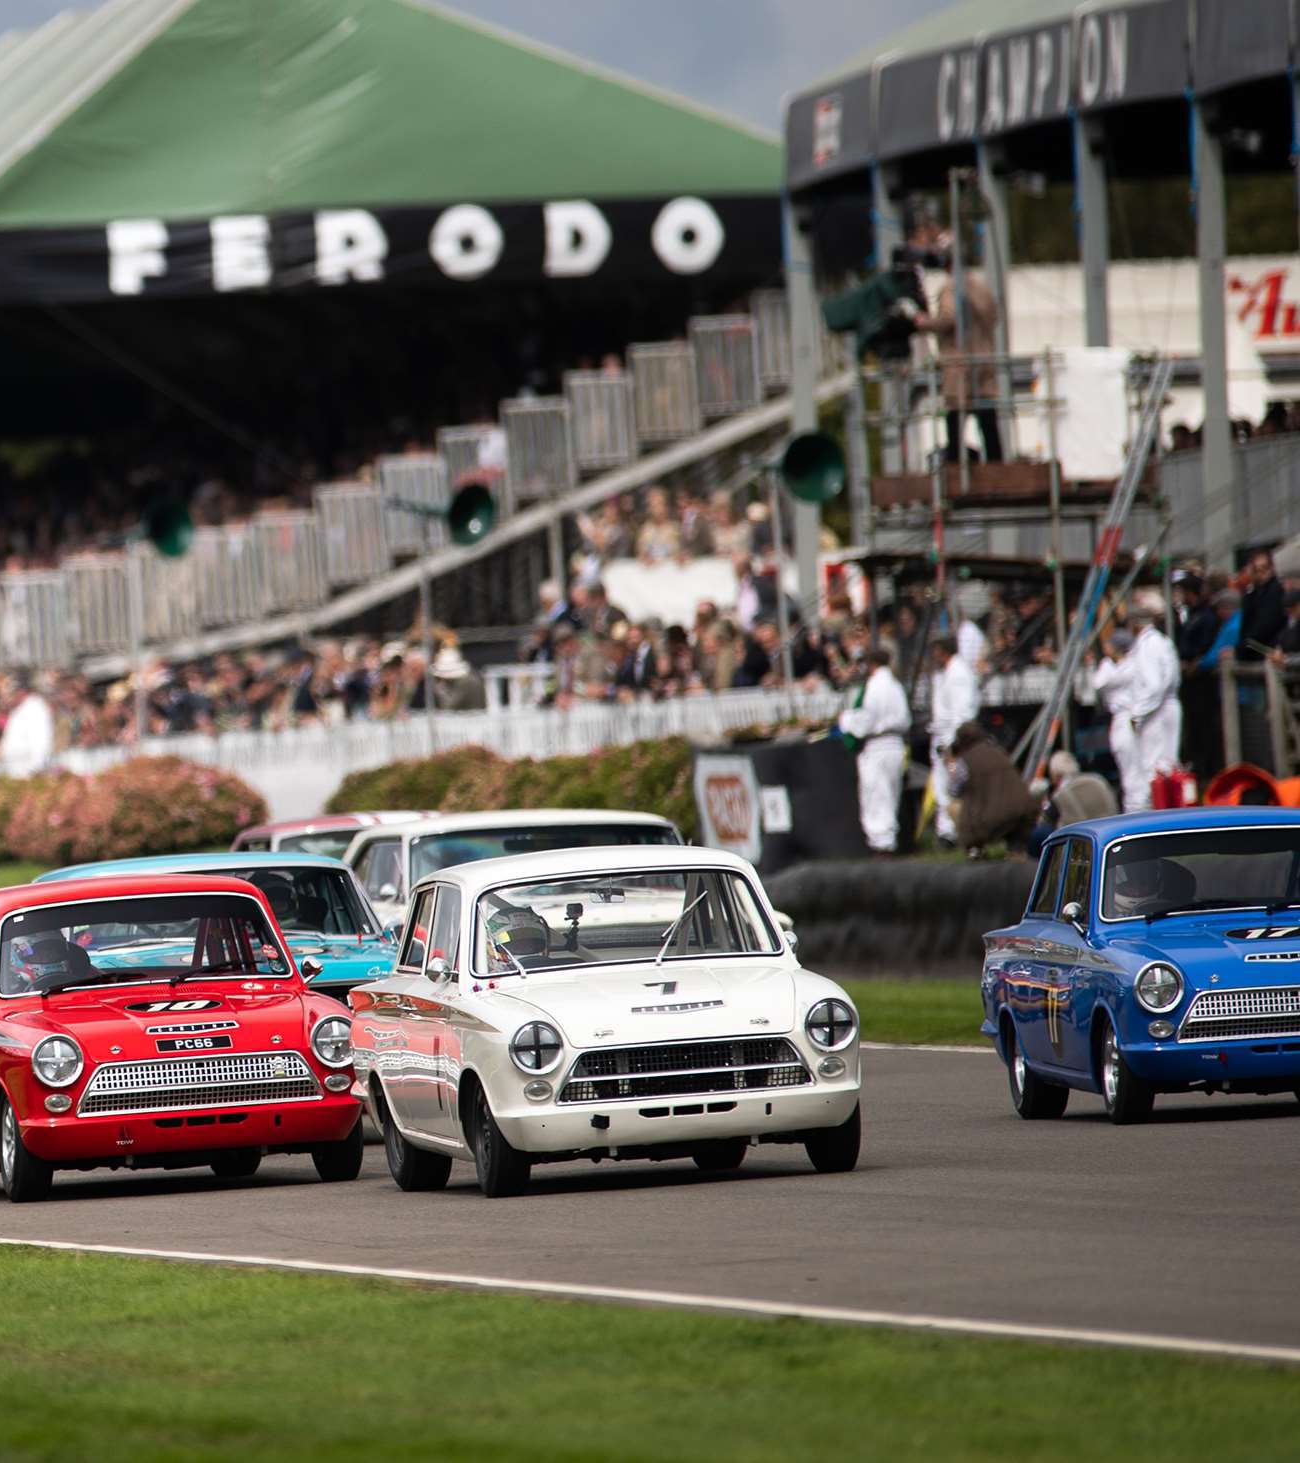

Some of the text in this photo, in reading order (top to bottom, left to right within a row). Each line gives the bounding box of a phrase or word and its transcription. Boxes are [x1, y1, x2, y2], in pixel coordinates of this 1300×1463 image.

[937, 11, 1128, 142] CHAMPION
[106, 197, 724, 295] FERODO
[1245, 926, 1300, 939] 17
[642, 981, 677, 995] 7
[147, 1000, 211, 1012] 10
[174, 1038, 214, 1050] PC66
